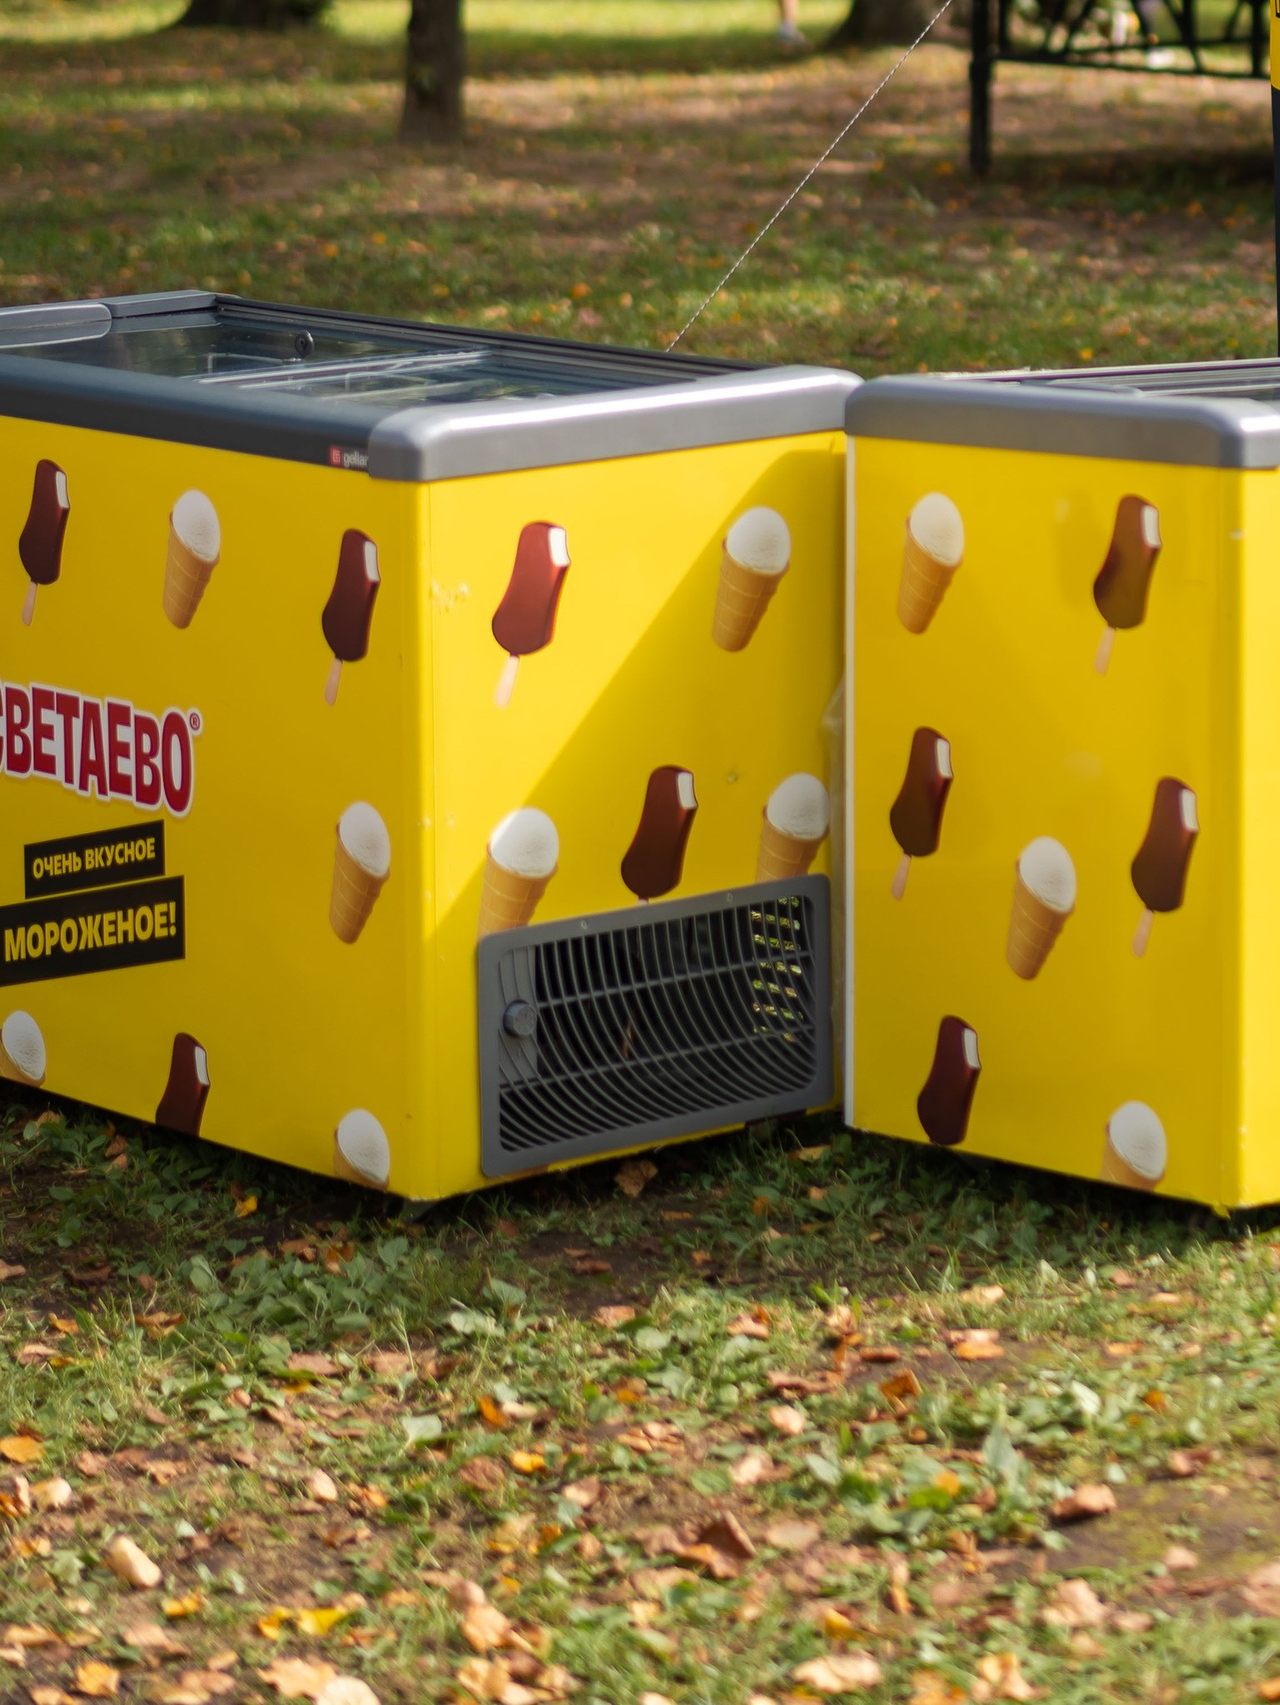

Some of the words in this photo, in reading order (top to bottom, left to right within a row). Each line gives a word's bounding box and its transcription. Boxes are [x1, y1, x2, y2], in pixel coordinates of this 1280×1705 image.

[0, 686, 192, 813] ВЕТАЕВО
[32, 856, 82, 879] ОЧЕНЬ
[85, 838, 156, 871] ВКУСНОЕ
[4, 901, 177, 962] МОРОЖЕНОЕ!
